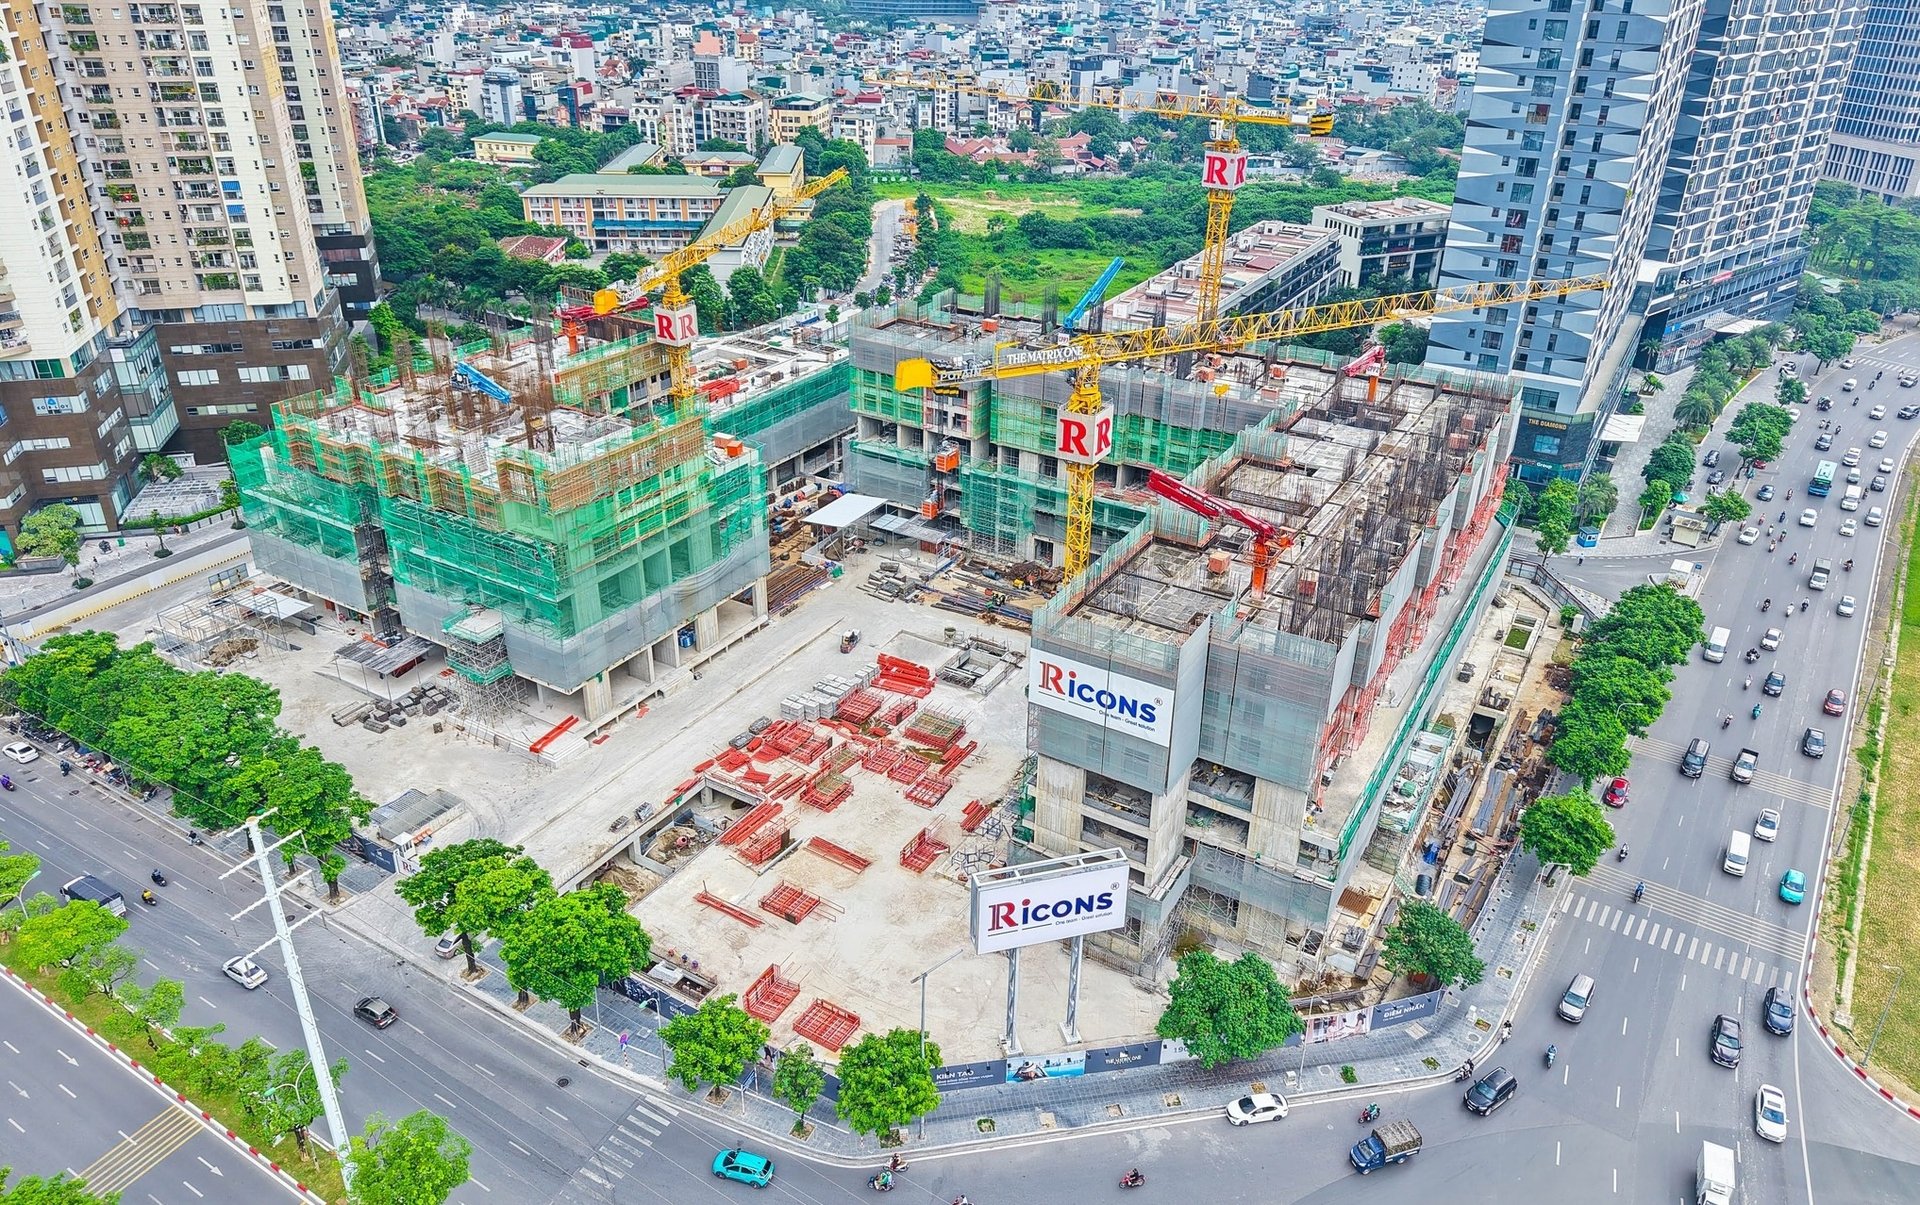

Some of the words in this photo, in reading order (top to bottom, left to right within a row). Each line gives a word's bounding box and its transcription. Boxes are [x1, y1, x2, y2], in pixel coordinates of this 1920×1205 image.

[1203, 155, 1228, 186] R
[1234, 156, 1246, 186] R
[655, 313, 676, 341] R
[678, 313, 696, 340] R
[1007, 353, 1027, 364] THE
[1027, 347, 1062, 362] MATRIX
[1063, 346, 1083, 358] ONE
[1059, 418, 1089, 457] R
[1095, 417, 1111, 456] R
[1528, 418, 1539, 426] THE
[1540, 420, 1567, 430] DIAMOND
